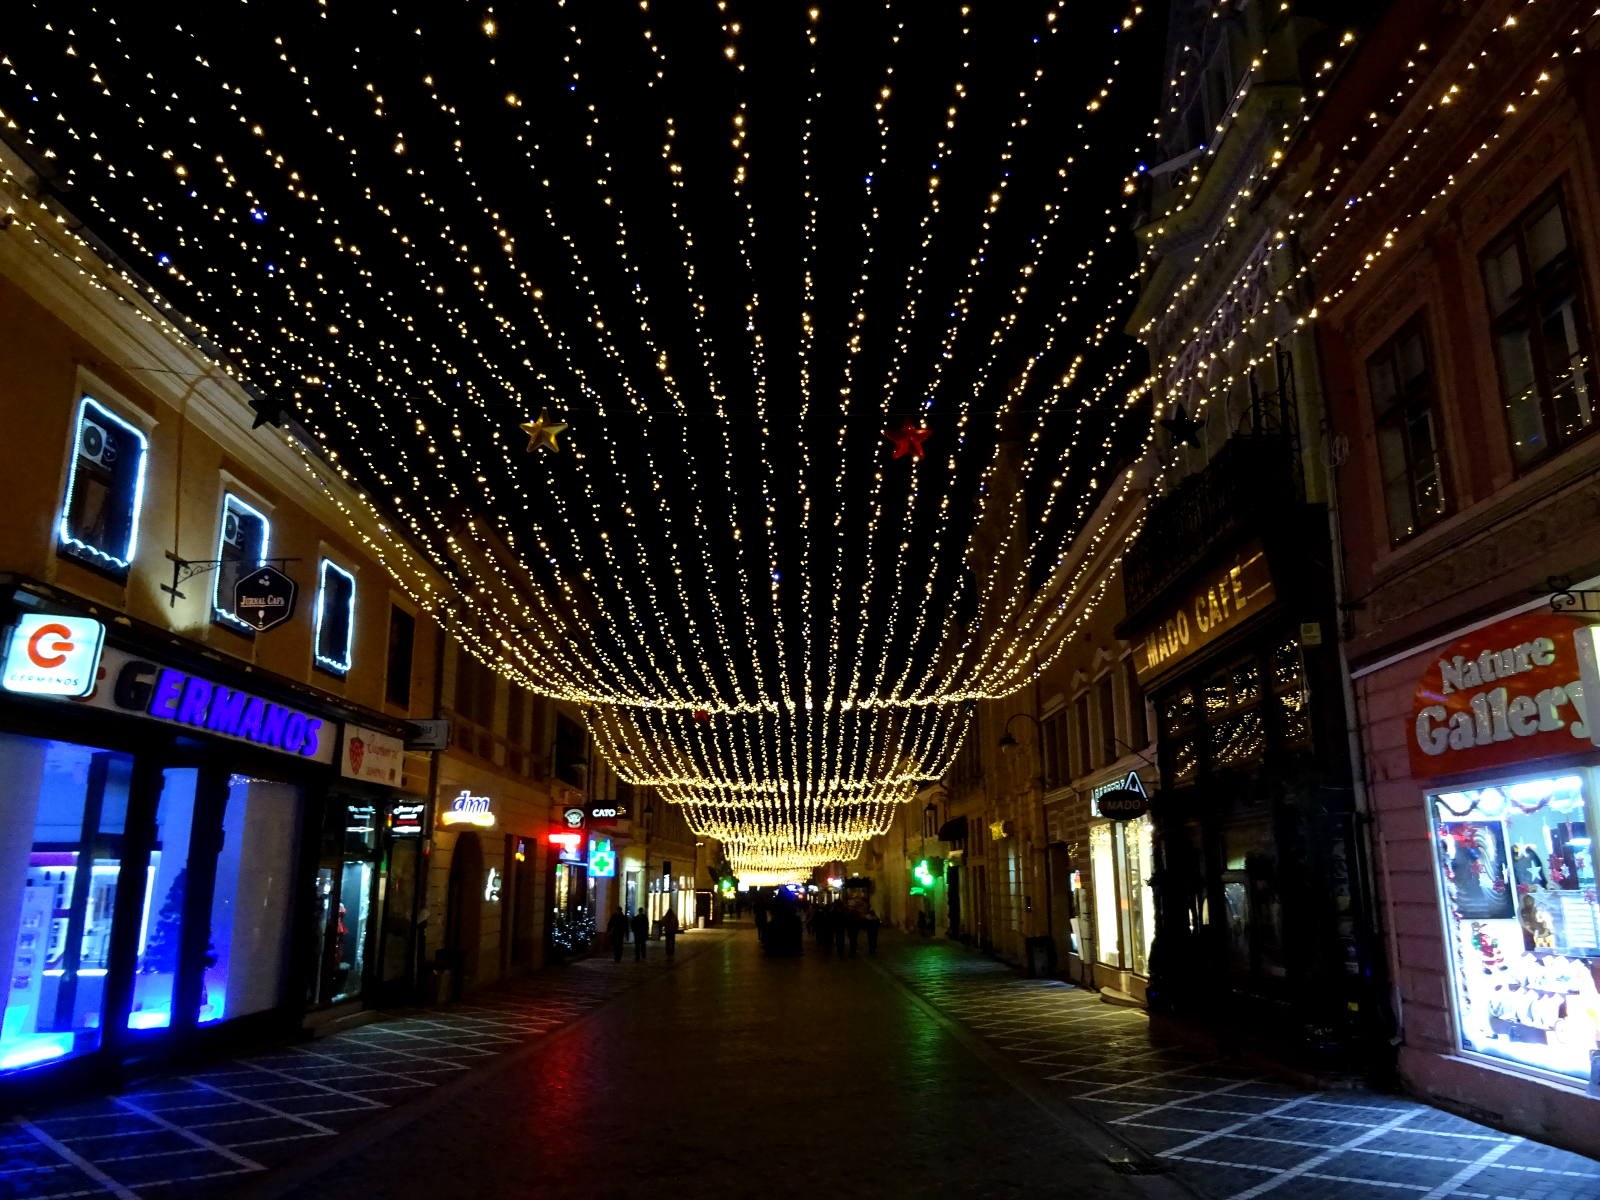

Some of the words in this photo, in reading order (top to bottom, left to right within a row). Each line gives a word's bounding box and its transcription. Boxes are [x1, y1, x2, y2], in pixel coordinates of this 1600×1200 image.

[1146, 609, 1190, 668] MADO
[1439, 636, 1556, 695] Nature
[114, 660, 322, 756] GERMANOS
[1416, 680, 1591, 757] Gallery
[452, 790, 490, 814] dm
[1107, 799, 1141, 811] MADO
